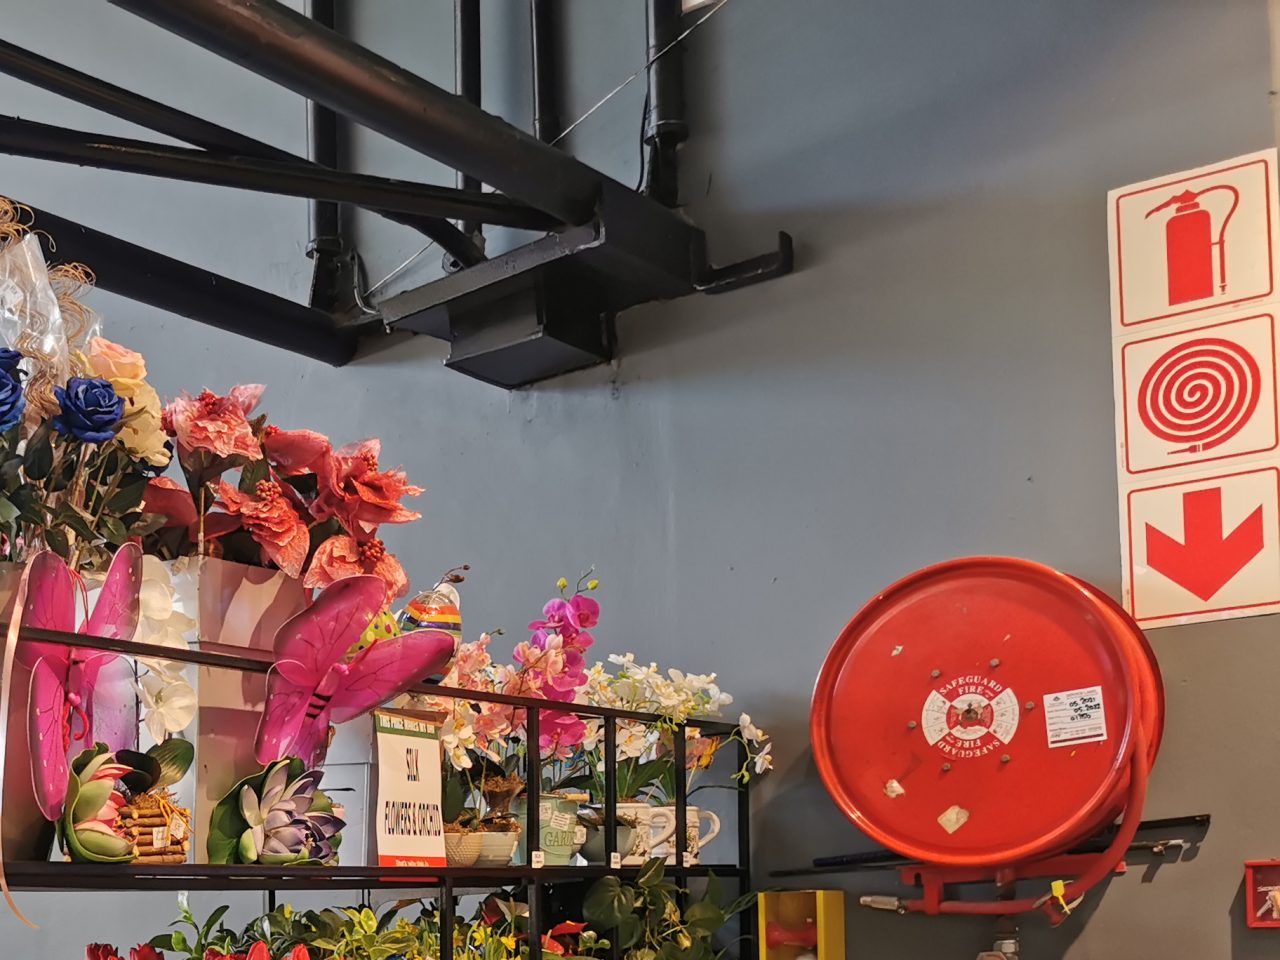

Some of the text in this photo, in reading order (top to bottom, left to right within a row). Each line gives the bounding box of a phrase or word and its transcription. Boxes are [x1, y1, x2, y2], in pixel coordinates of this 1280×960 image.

[939, 675, 1003, 695] SAFEGUARD
[957, 685, 985, 695] FIRE
[937, 739, 1001, 758] SAFEGUARD
[956, 739, 981, 748] FIRE
